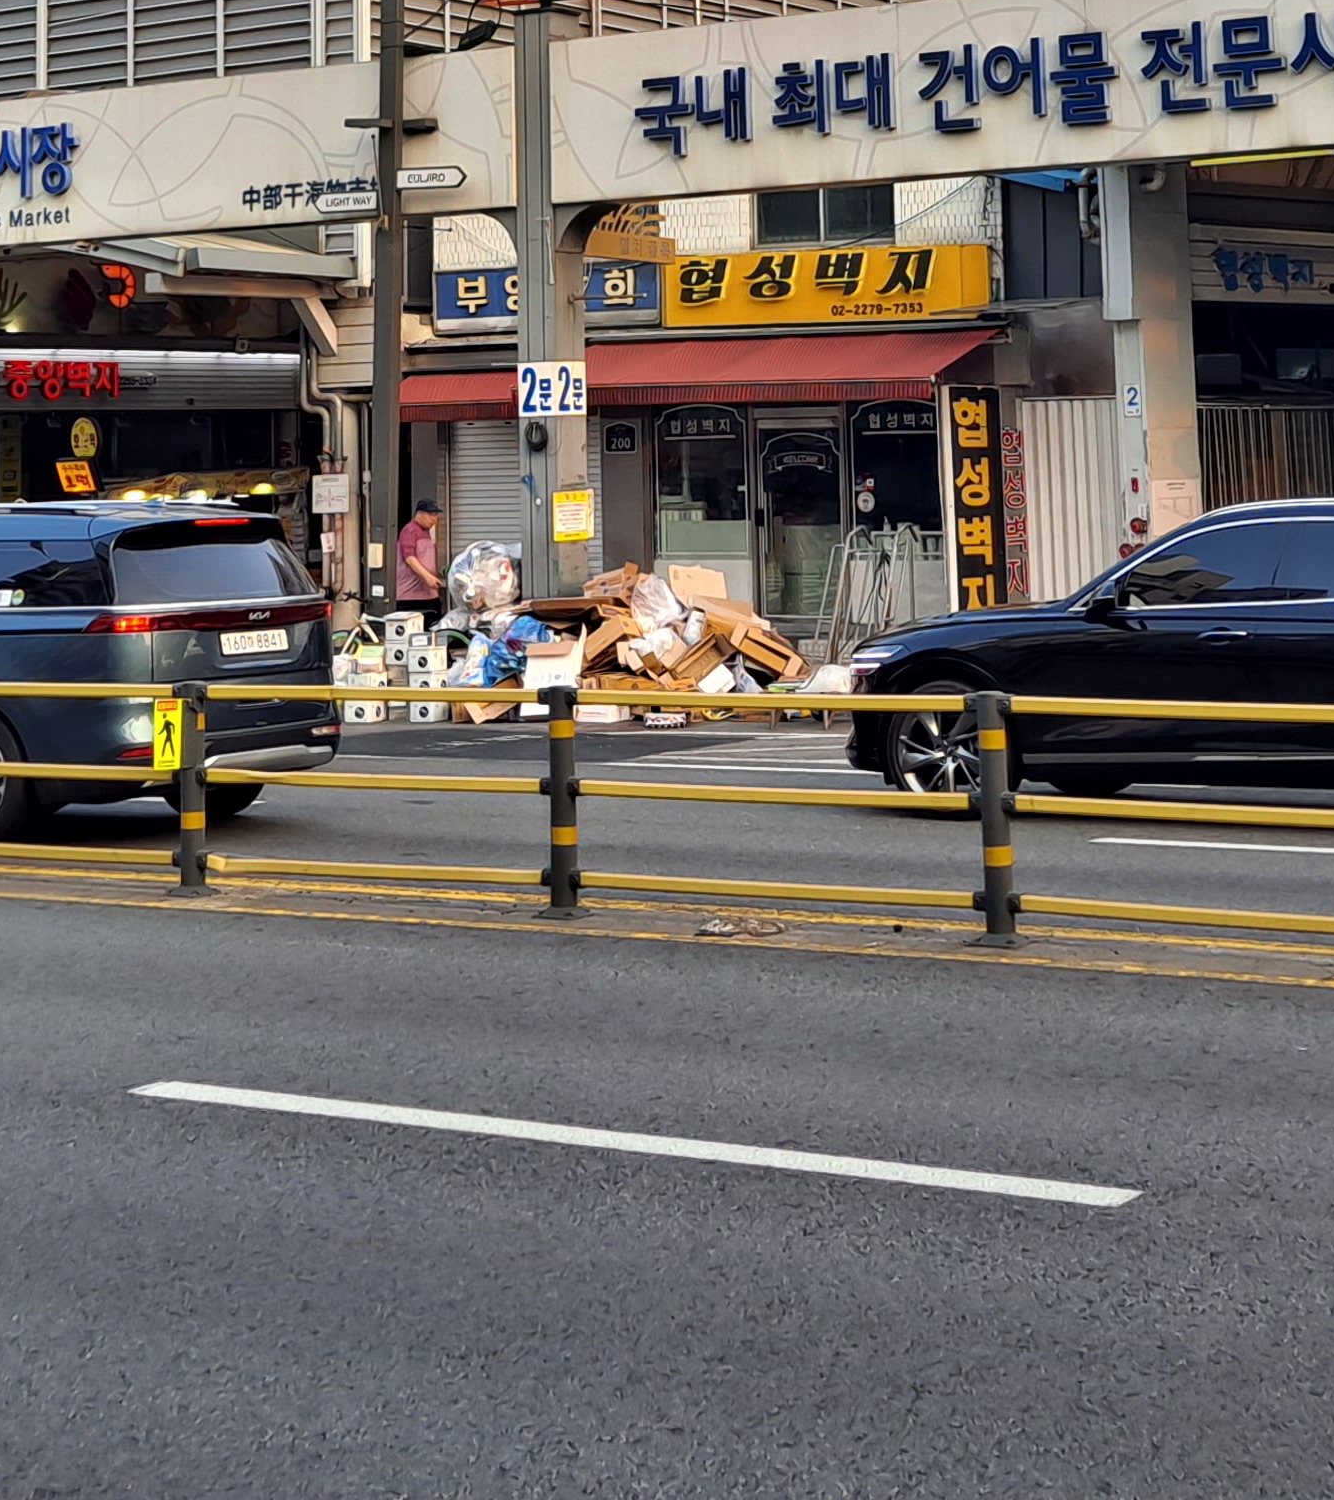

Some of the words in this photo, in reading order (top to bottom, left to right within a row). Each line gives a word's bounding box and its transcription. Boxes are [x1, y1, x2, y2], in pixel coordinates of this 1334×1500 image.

[634, 65, 753, 157] 국내
[772, 52, 897, 137] 최대
[918, 30, 1120, 133] 건어물
[325, 196, 351, 208] LIGHT
[353, 195, 373, 206] WAY
[8, 206, 72, 228] Market
[679, 248, 935, 306] 협성벽지
[830, 302, 924, 317] 02-2279-7353
[3, 360, 120, 400] 중앙벽지
[521, 367, 553, 412] 2문
[558, 366, 584, 412] 2문
[1126, 386, 1139, 407] 2
[670, 417, 732, 435] 협성벽지
[868, 412, 934, 429] 협성벽지
[610, 437, 631, 450] 200
[953, 397, 996, 610] 협성벽지
[1002, 426, 1031, 598] 협성벽지
[257, 631, 284, 648] 8841
